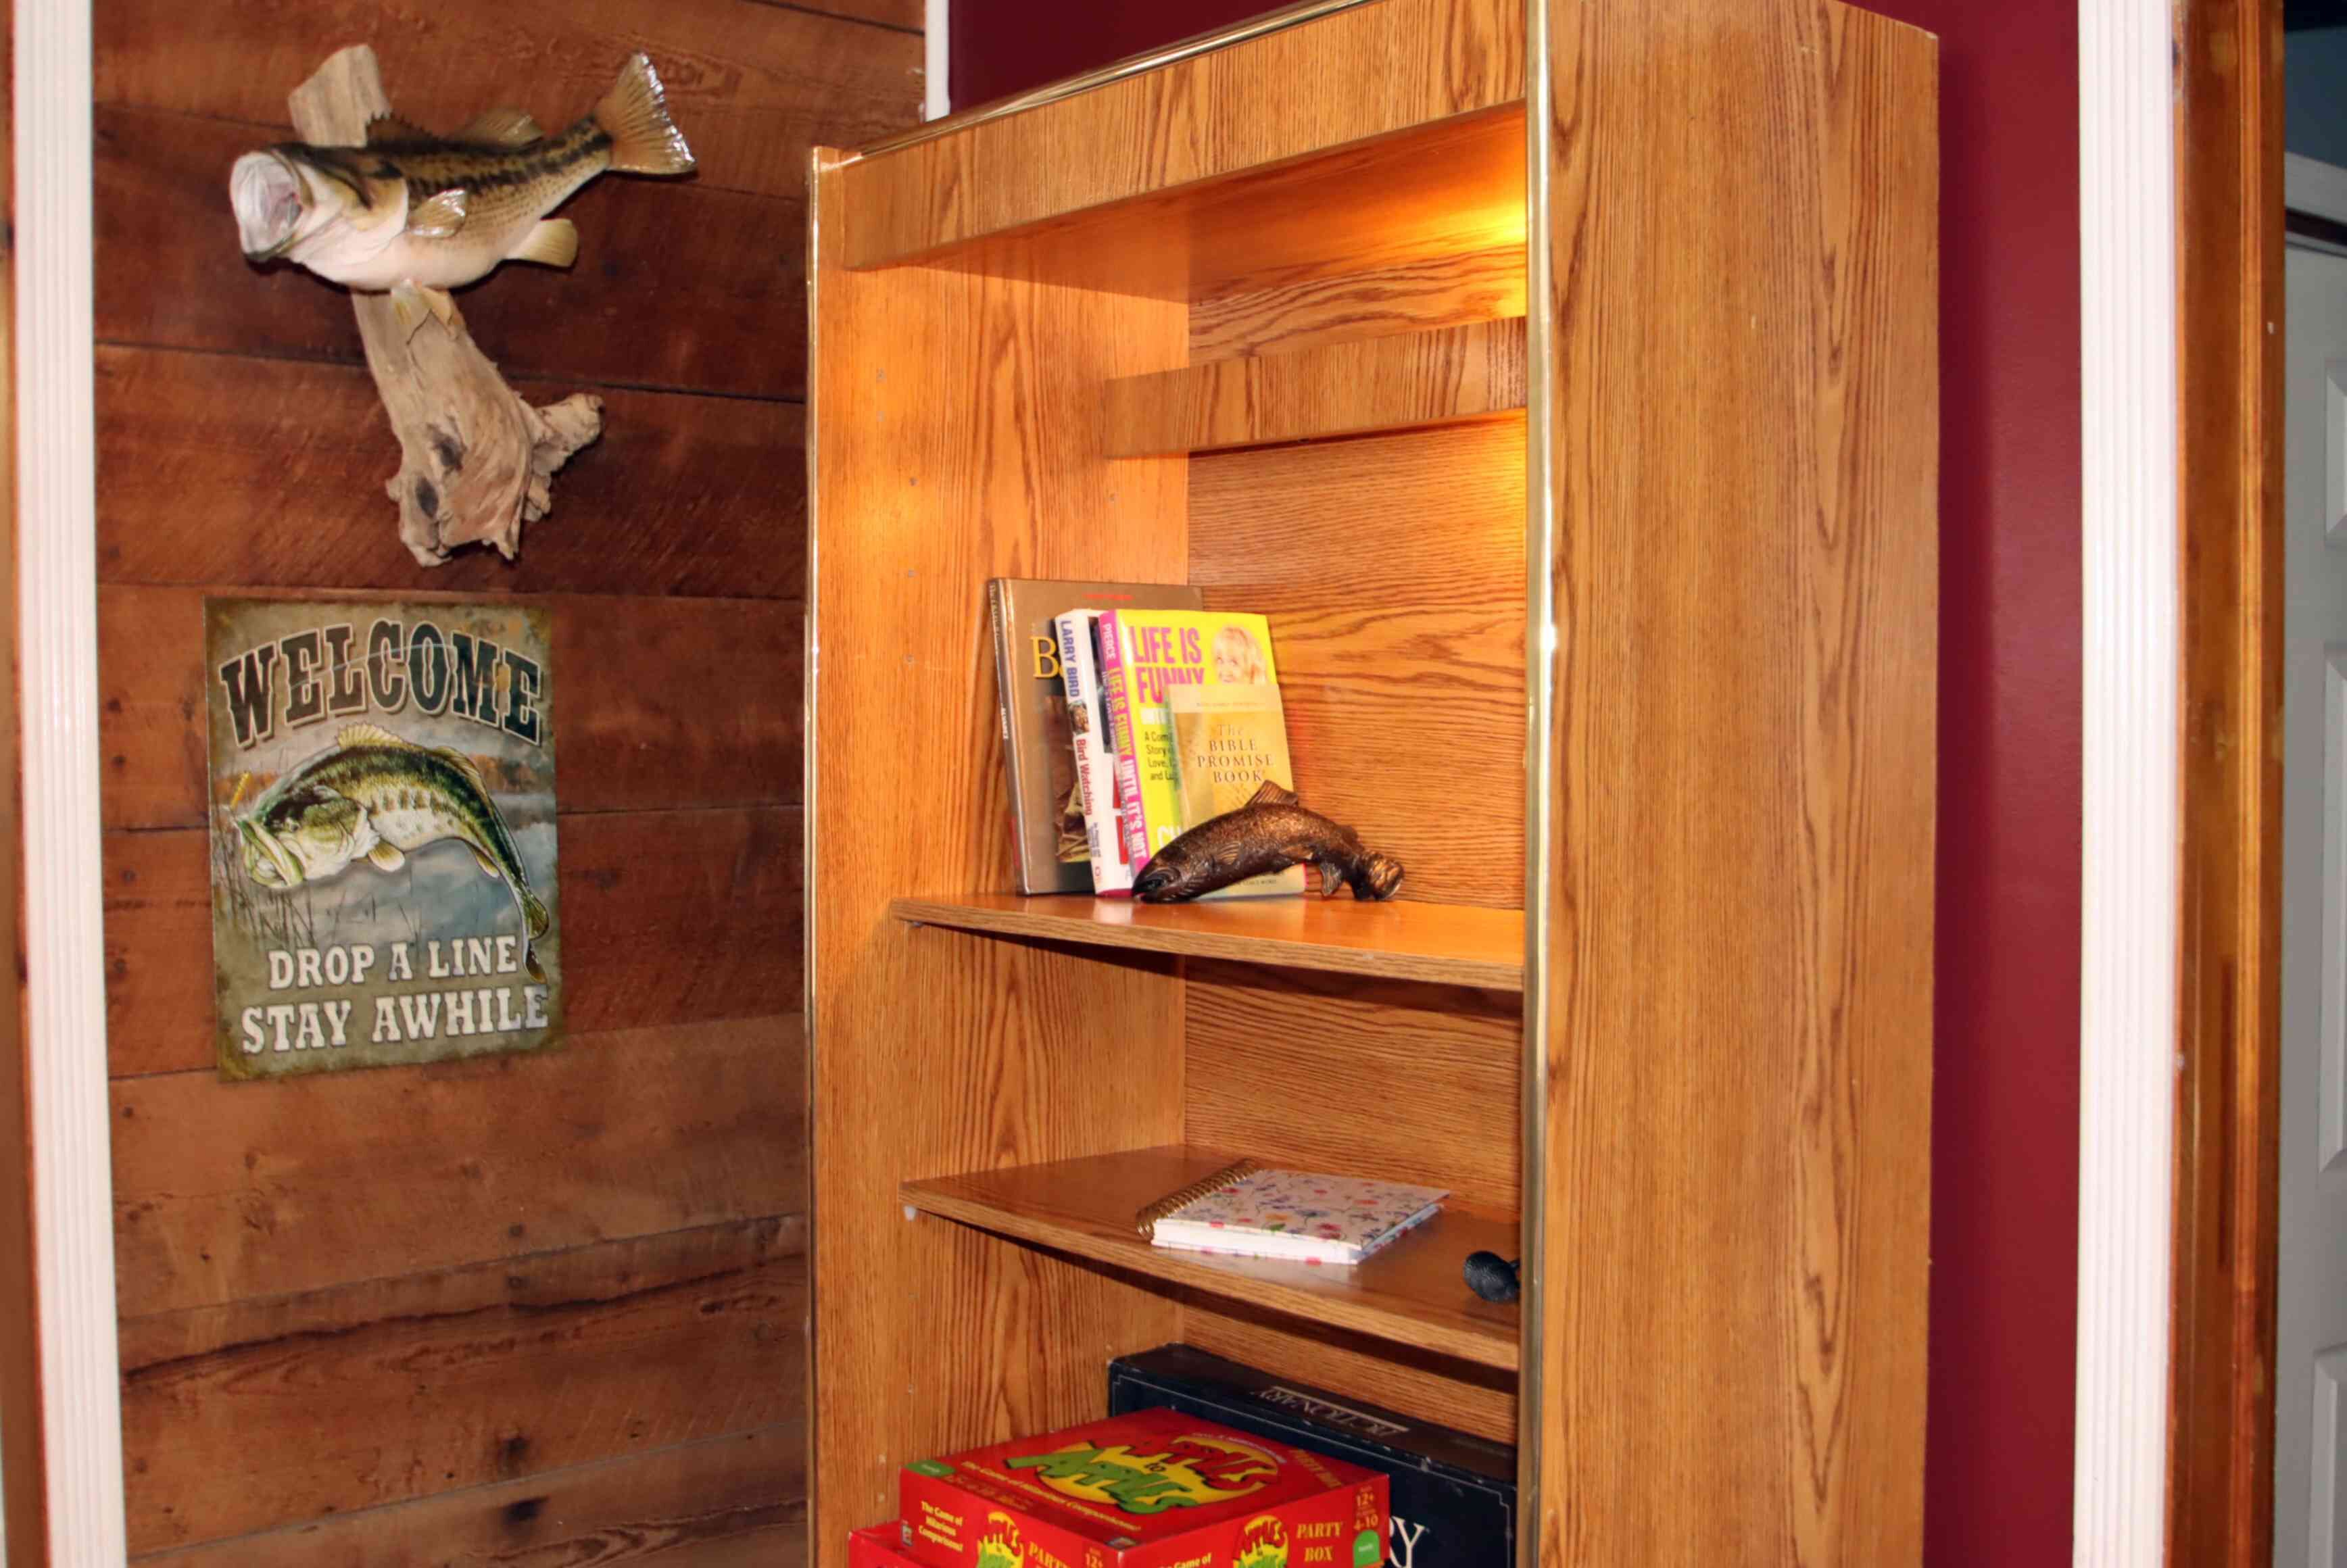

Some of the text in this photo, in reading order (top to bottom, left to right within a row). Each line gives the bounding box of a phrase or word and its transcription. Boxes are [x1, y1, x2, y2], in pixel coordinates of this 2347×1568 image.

[1103, 622, 1116, 660] PIERCE
[1129, 626, 1201, 664] LIFE IS
[1031, 636, 1063, 678] B
[1061, 620, 1080, 697] LARRY BIRD
[218, 618, 540, 747] WELCOME
[1107, 666, 1123, 693] LIFE
[1112, 696, 1126, 712] IS
[1113, 713, 1133, 756] FUNNY
[1217, 724, 1244, 736] The
[1146, 744, 1166, 757] Story
[1209, 738, 1257, 752] BIBLE
[1196, 754, 1274, 768] PROMISE
[1076, 739, 1094, 815] Bird Watching
[1151, 770, 1163, 781] and
[1213, 770, 1263, 783] BOOK
[269, 935, 518, 990] DROP A LINE
[241, 983, 549, 1055] STAY AWHILE
[1356, 1492, 1374, 1507] 12+
[921, 1500, 963, 1527] The Game of
[1353, 1513, 1379, 1532] 4-10
[925, 1515, 957, 1536] Hilarious
[1297, 1521, 1342, 1540] PARTY
[1201, 1552, 1212, 1564] of
[1304, 1546, 1334, 1563] BOX
